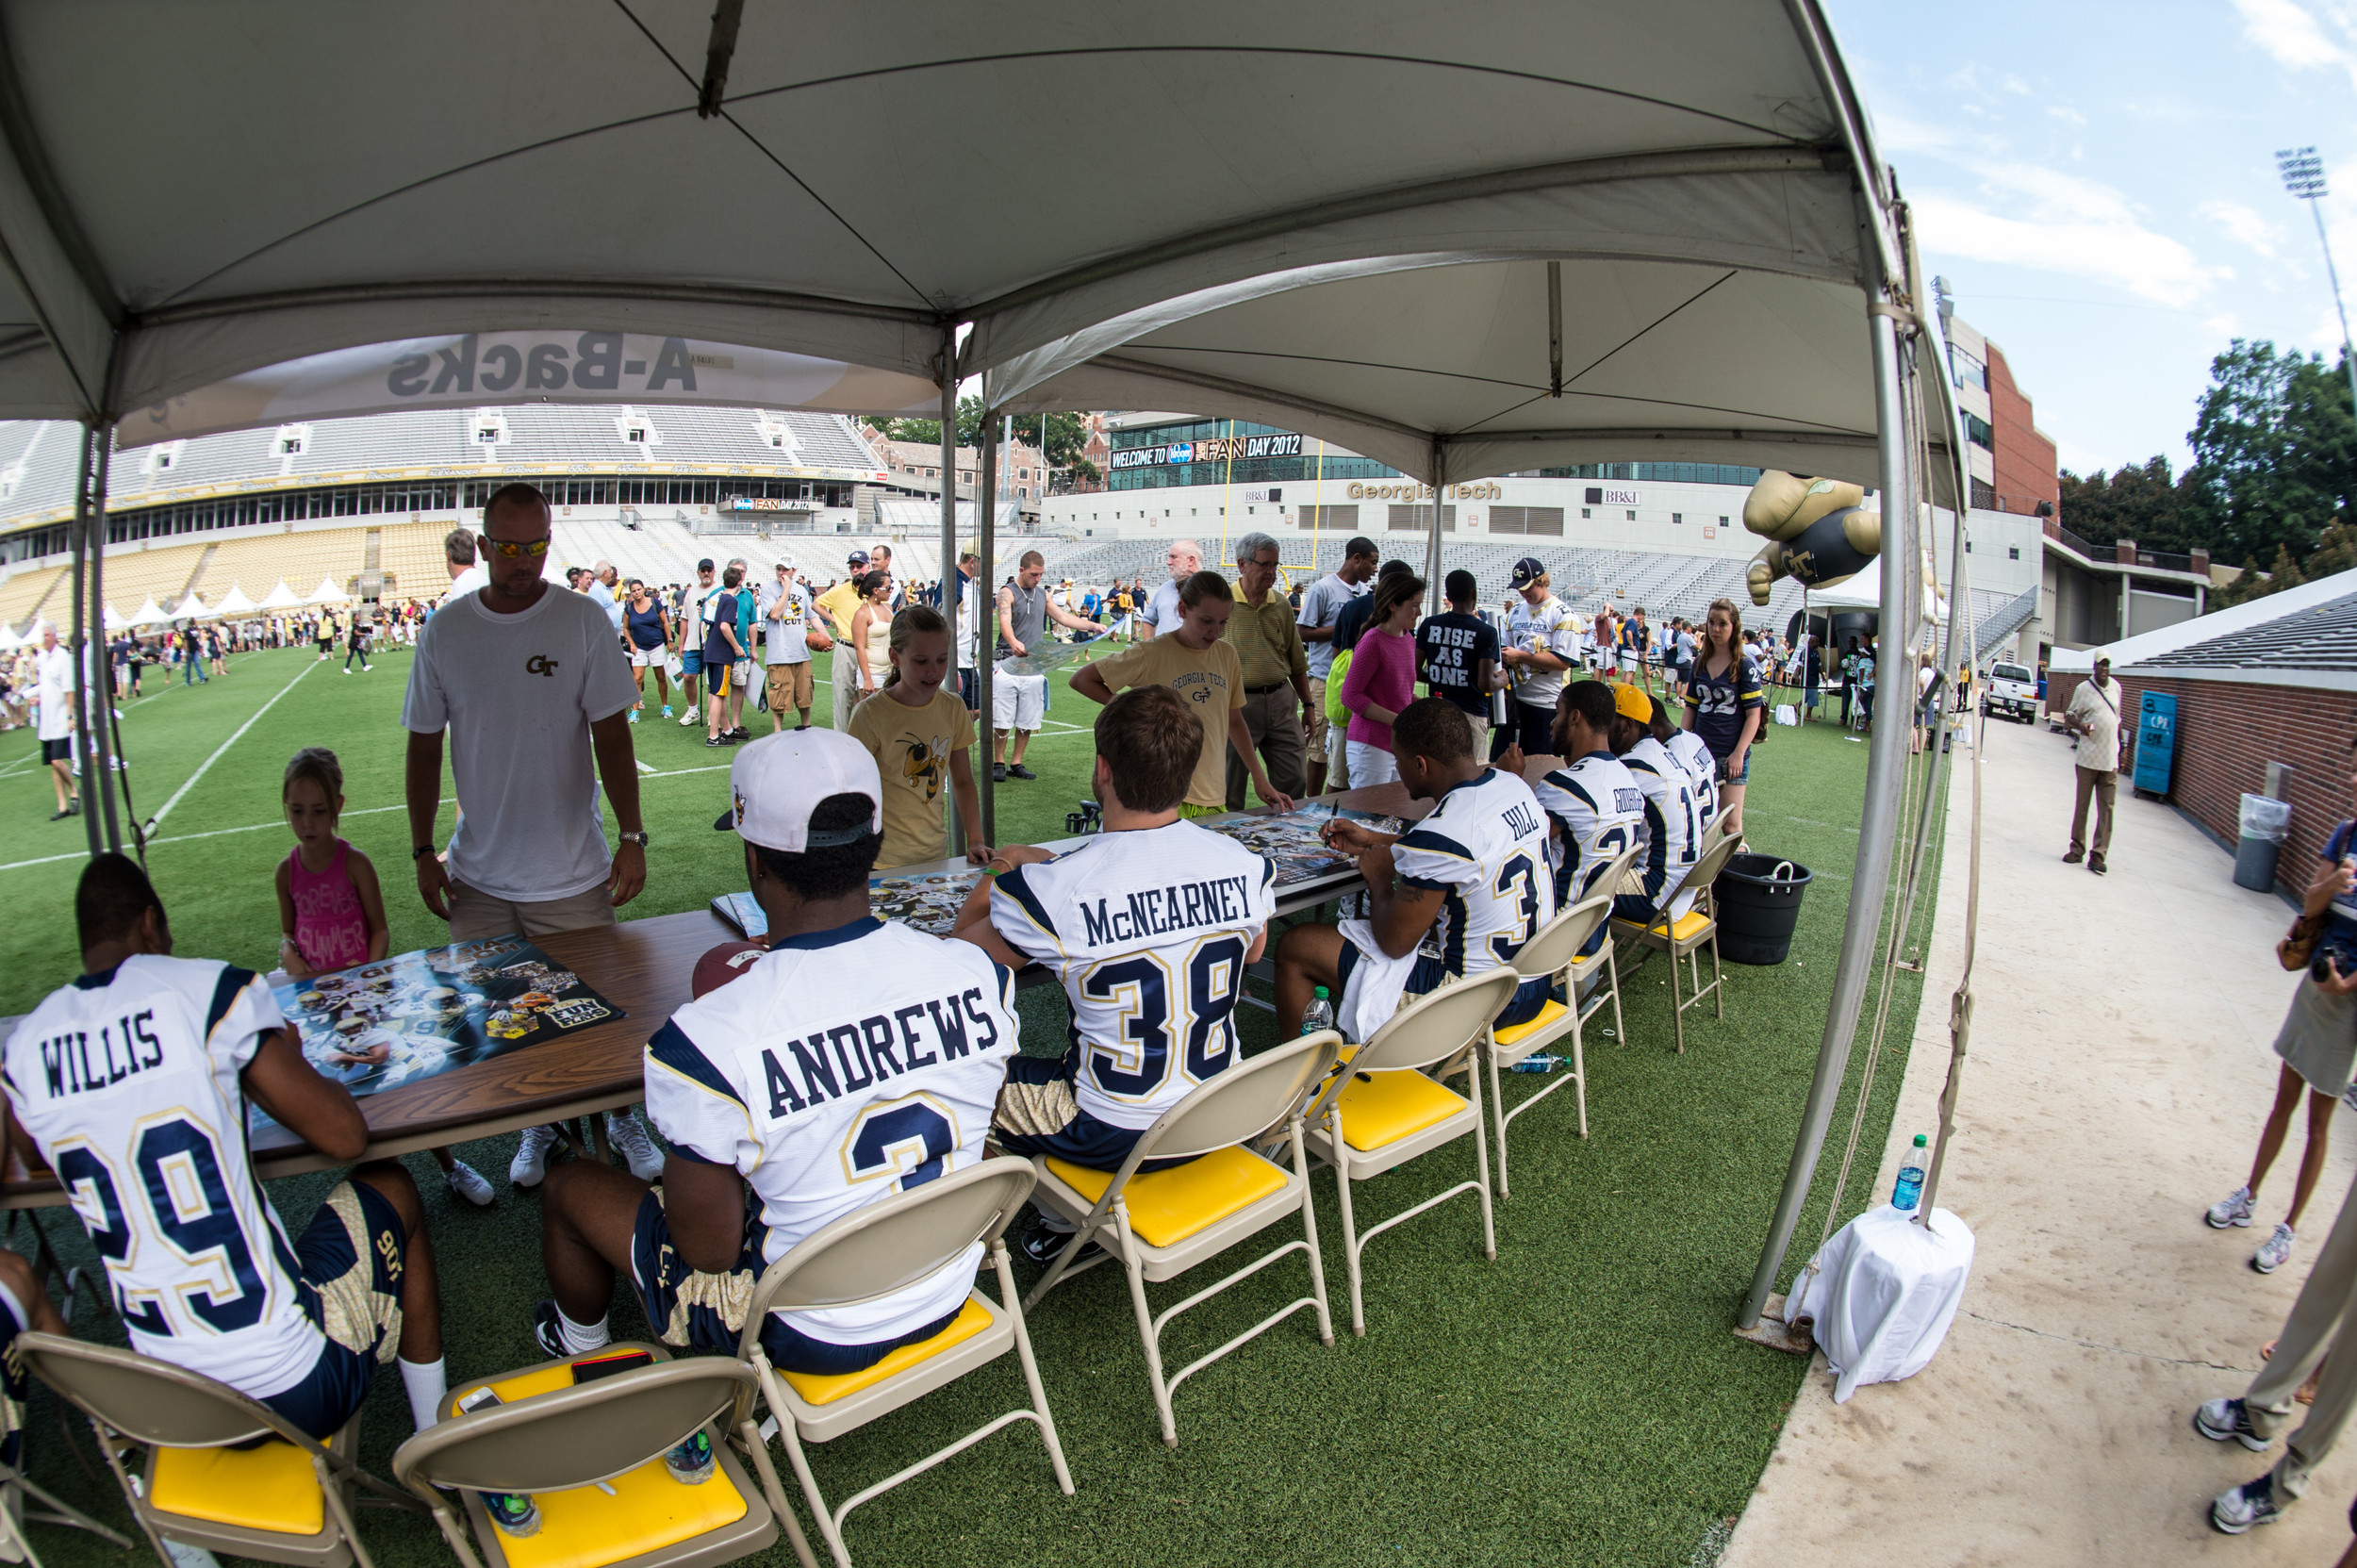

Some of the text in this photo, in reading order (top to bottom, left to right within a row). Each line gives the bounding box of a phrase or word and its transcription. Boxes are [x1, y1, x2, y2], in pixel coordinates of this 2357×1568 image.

[1113, 450, 1152, 469] WELCOME
[1153, 447, 1166, 465] TO
[1206, 437, 1246, 460] FAN
[1247, 437, 1272, 457] DAY
[1271, 435, 1300, 455] 2012
[1347, 481, 1501, 503] Georgia Tech
[1605, 489, 1640, 504] BB&T
[756, 500, 779, 510] FAN
[780, 501, 794, 510] DAY
[793, 502, 810, 510] 2012
[783, 618, 801, 626] CUT
[1426, 626, 1477, 650] RISE
[1435, 647, 1463, 668] AS
[1172, 672, 1206, 691] GEORGIA
[1428, 666, 1469, 687] ONE
[1697, 684, 1738, 716] 22
[1501, 801, 1540, 842] HILL
[1080, 874, 1251, 948] McNEARNEY
[1078, 929, 1249, 1104] 38
[40, 1009, 164, 1099] WILLIS
[762, 987, 998, 1120] ANDREWS
